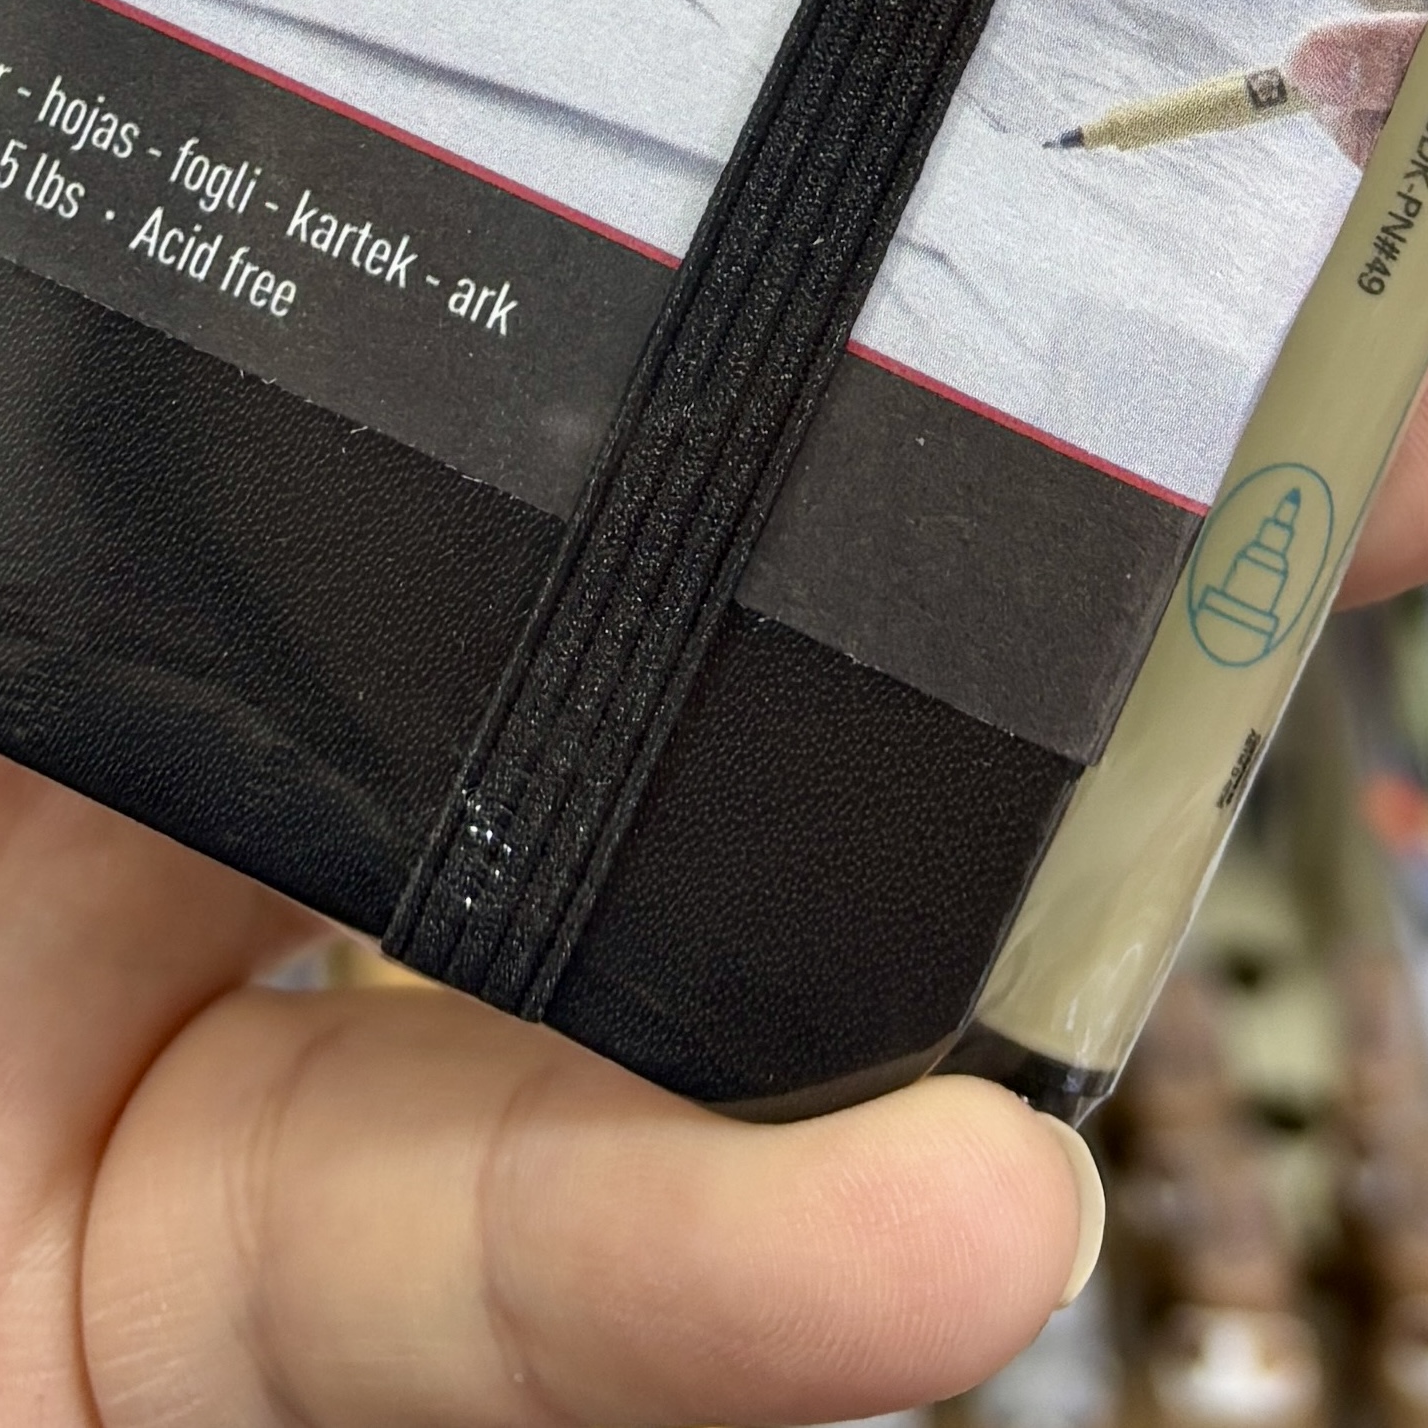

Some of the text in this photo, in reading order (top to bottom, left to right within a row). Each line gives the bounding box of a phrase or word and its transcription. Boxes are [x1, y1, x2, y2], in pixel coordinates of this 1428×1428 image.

[24, 153, 86, 221] lbs
[128, 205, 224, 284] Acid
[219, 246, 298, 318] free
[36, 74, 141, 160] hojas
[170, 136, 262, 215] fogli
[285, 189, 419, 288] kartek
[447, 276, 519, 336] ark
